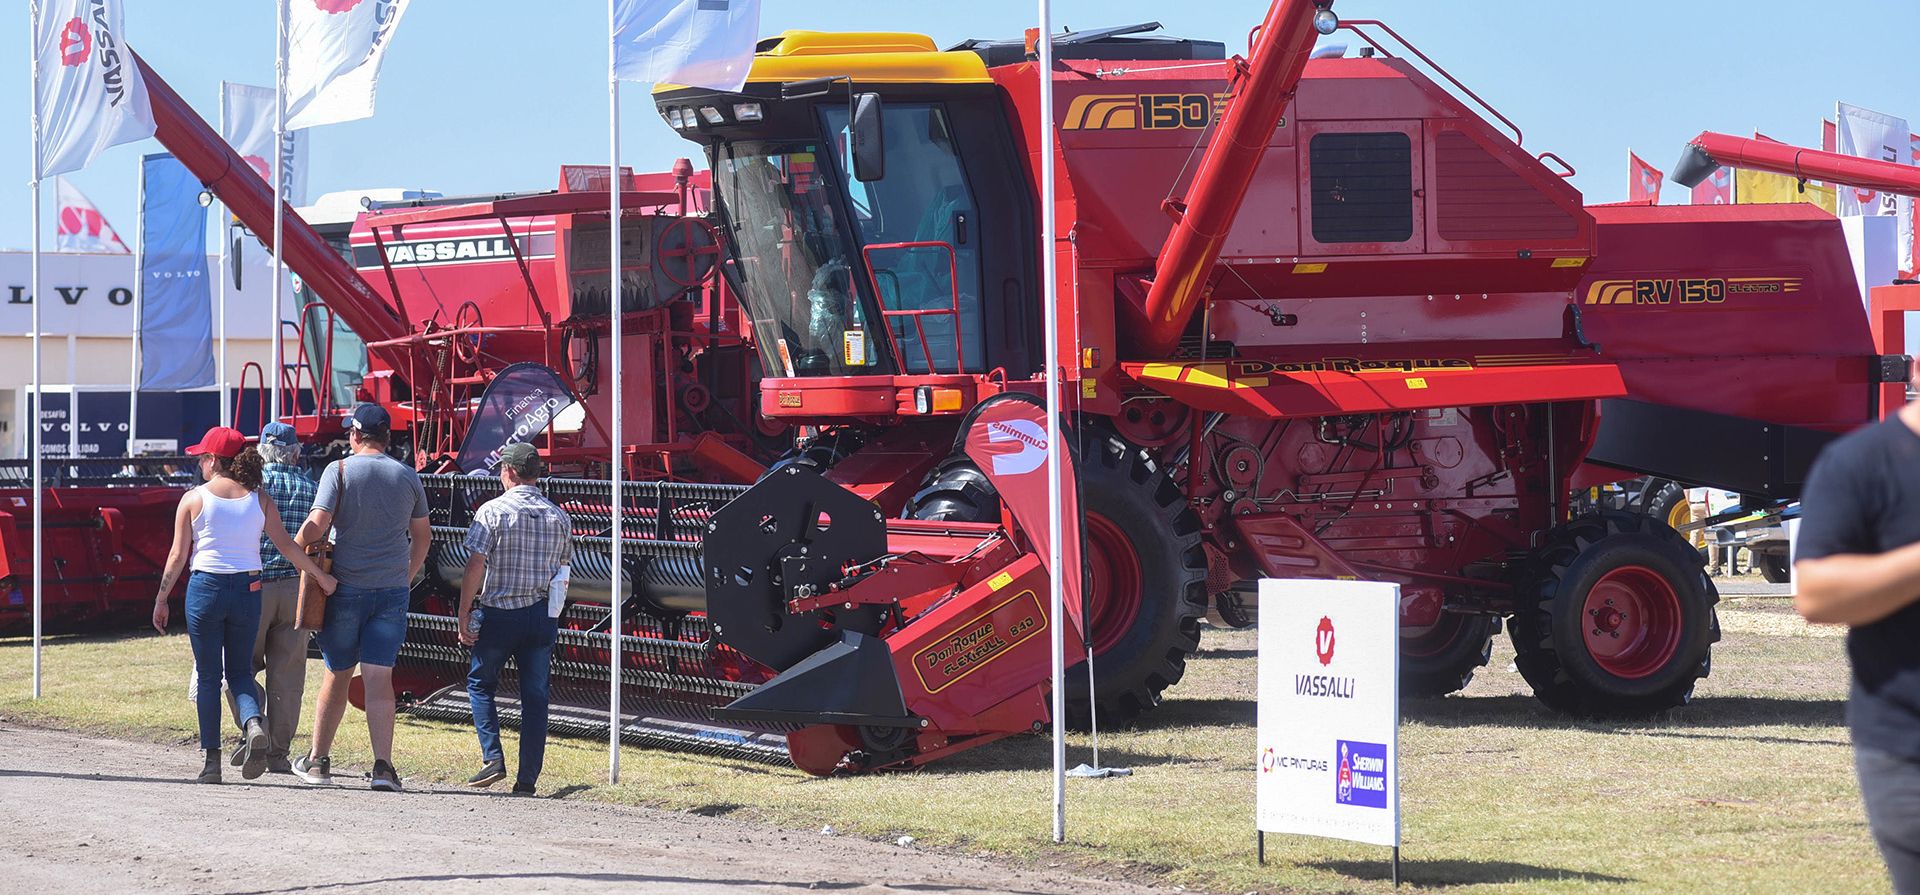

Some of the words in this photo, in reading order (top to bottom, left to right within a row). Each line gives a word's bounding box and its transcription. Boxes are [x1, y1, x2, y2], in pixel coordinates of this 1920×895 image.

[1139, 93, 1210, 130] 150
[153, 270, 201, 279] VOLVO
[1636, 279, 1674, 304] RV
[1678, 278, 1726, 304] 150
[1728, 283, 1780, 293] ELECTRO
[1232, 359, 1324, 375] Don
[1322, 356, 1474, 373] Roque
[41, 422, 129, 432] VOLVO
[1009, 616, 1035, 637] 840
[926, 646, 953, 668] Don
[951, 623, 994, 653] Roque
[1277, 756, 1288, 768] MC
[1290, 757, 1328, 772] PINTURAS
